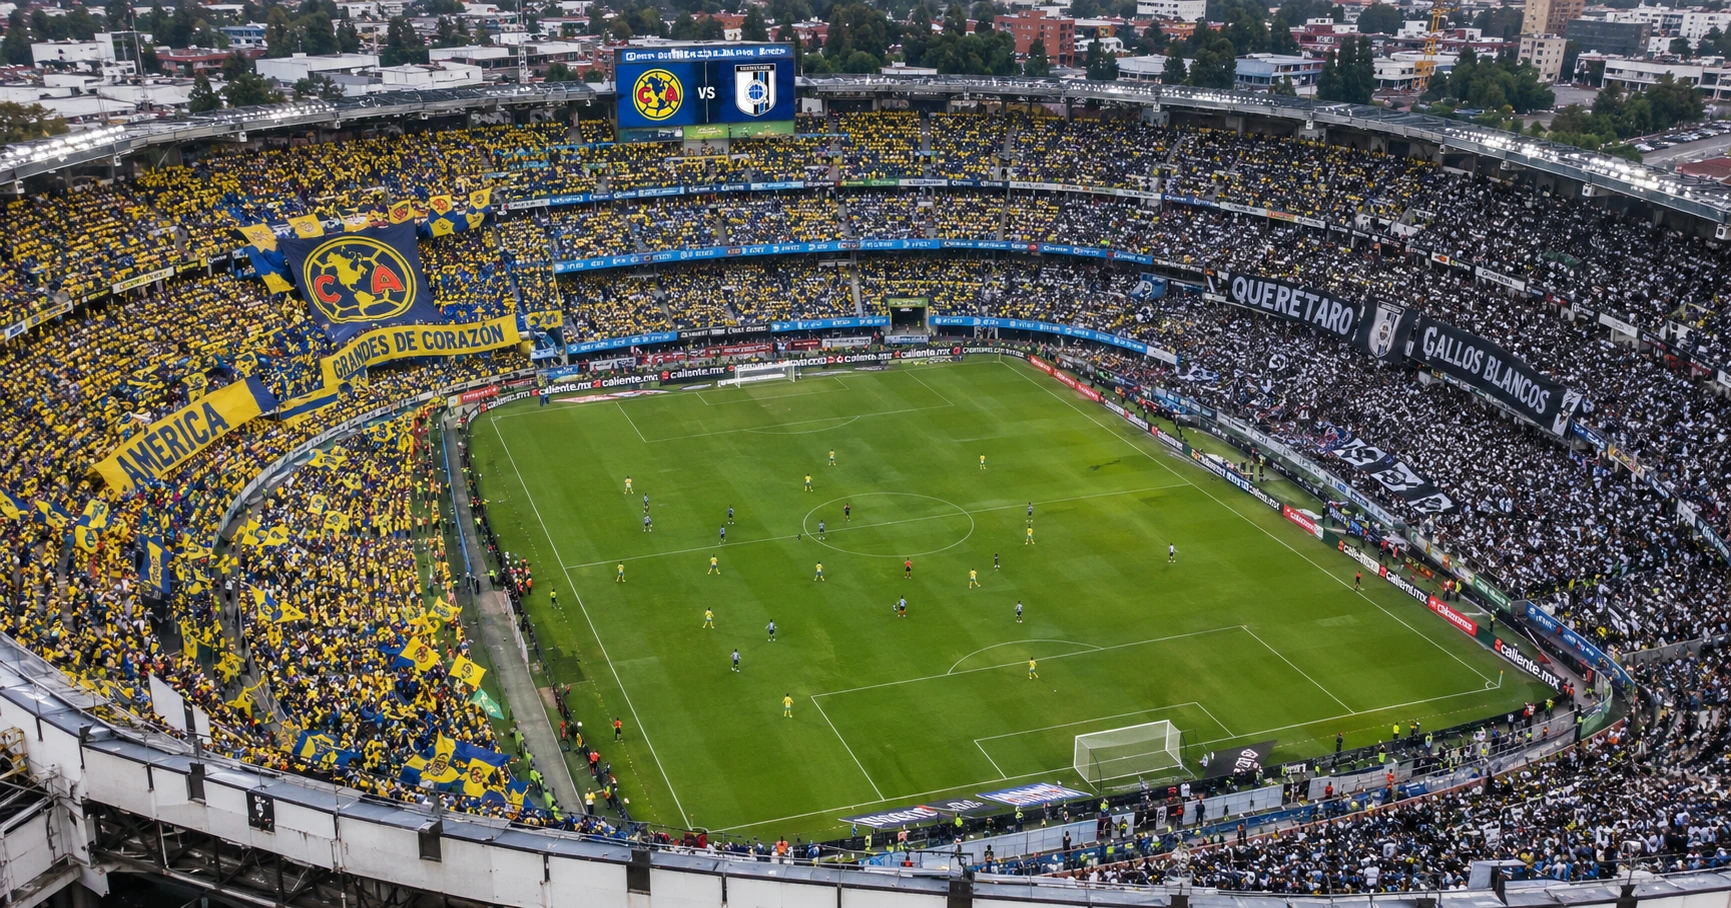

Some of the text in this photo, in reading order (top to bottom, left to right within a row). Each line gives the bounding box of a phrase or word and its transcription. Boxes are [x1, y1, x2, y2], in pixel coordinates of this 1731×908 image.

[697, 86, 716, 100] VS
[332, 322, 505, 380] GRANDES DE CORAZÓN
[1422, 326, 1551, 415] GALLOS BLANCOS
[1500, 643, 1560, 690] caliente.mx
